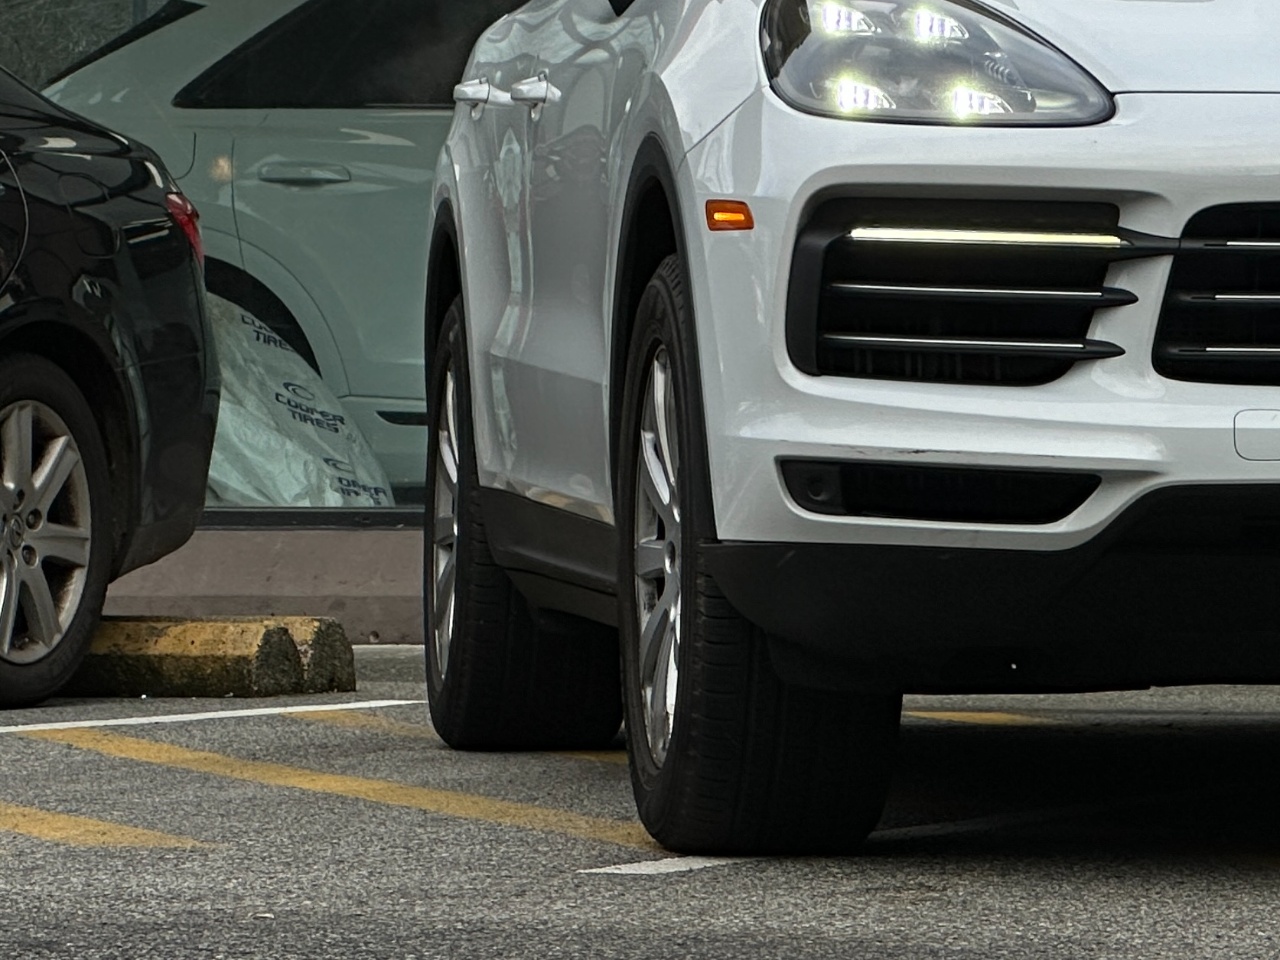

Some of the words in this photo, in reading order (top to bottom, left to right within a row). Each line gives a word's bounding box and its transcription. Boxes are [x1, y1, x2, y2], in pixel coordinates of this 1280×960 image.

[252, 329, 296, 352] TIRE
[275, 392, 346, 426] COOPER
[287, 408, 340, 434] TIRES
